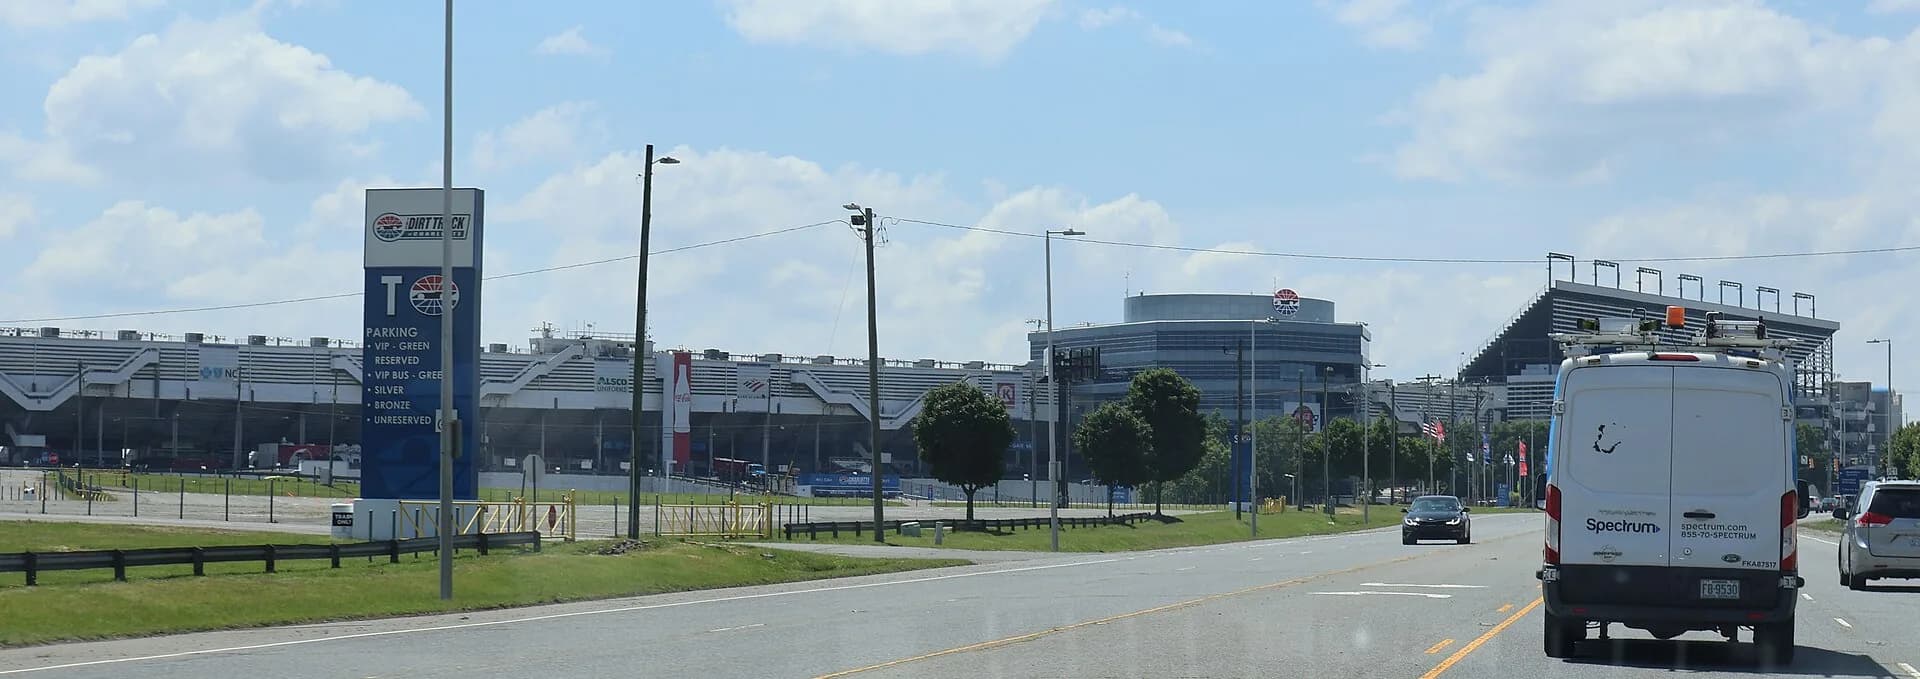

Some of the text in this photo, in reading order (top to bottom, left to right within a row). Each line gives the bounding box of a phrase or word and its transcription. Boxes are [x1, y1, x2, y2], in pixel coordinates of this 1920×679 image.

[408, 217, 432, 229] DIRT
[433, 217, 465, 229] TRCK
[381, 276, 402, 315] T
[366, 327, 418, 337] PARKING
[374, 342, 390, 350] VIP
[399, 341, 430, 350] GREEN
[375, 356, 420, 365] RESERVED
[374, 371, 390, 379] VIP
[392, 371, 409, 379] BUS
[418, 371, 443, 379] GREE
[597, 376, 628, 386] ALSCO
[374, 386, 404, 394] SILVER
[374, 401, 411, 409] BRONZE
[374, 416, 432, 424] UNRESERVED
[1586, 518, 1656, 534] Spectrum
[1681, 523, 1748, 531] spectrum.com
[1681, 531, 1757, 540] 855-70-SPECTRUM
[1742, 560, 1777, 569] FKA87517
